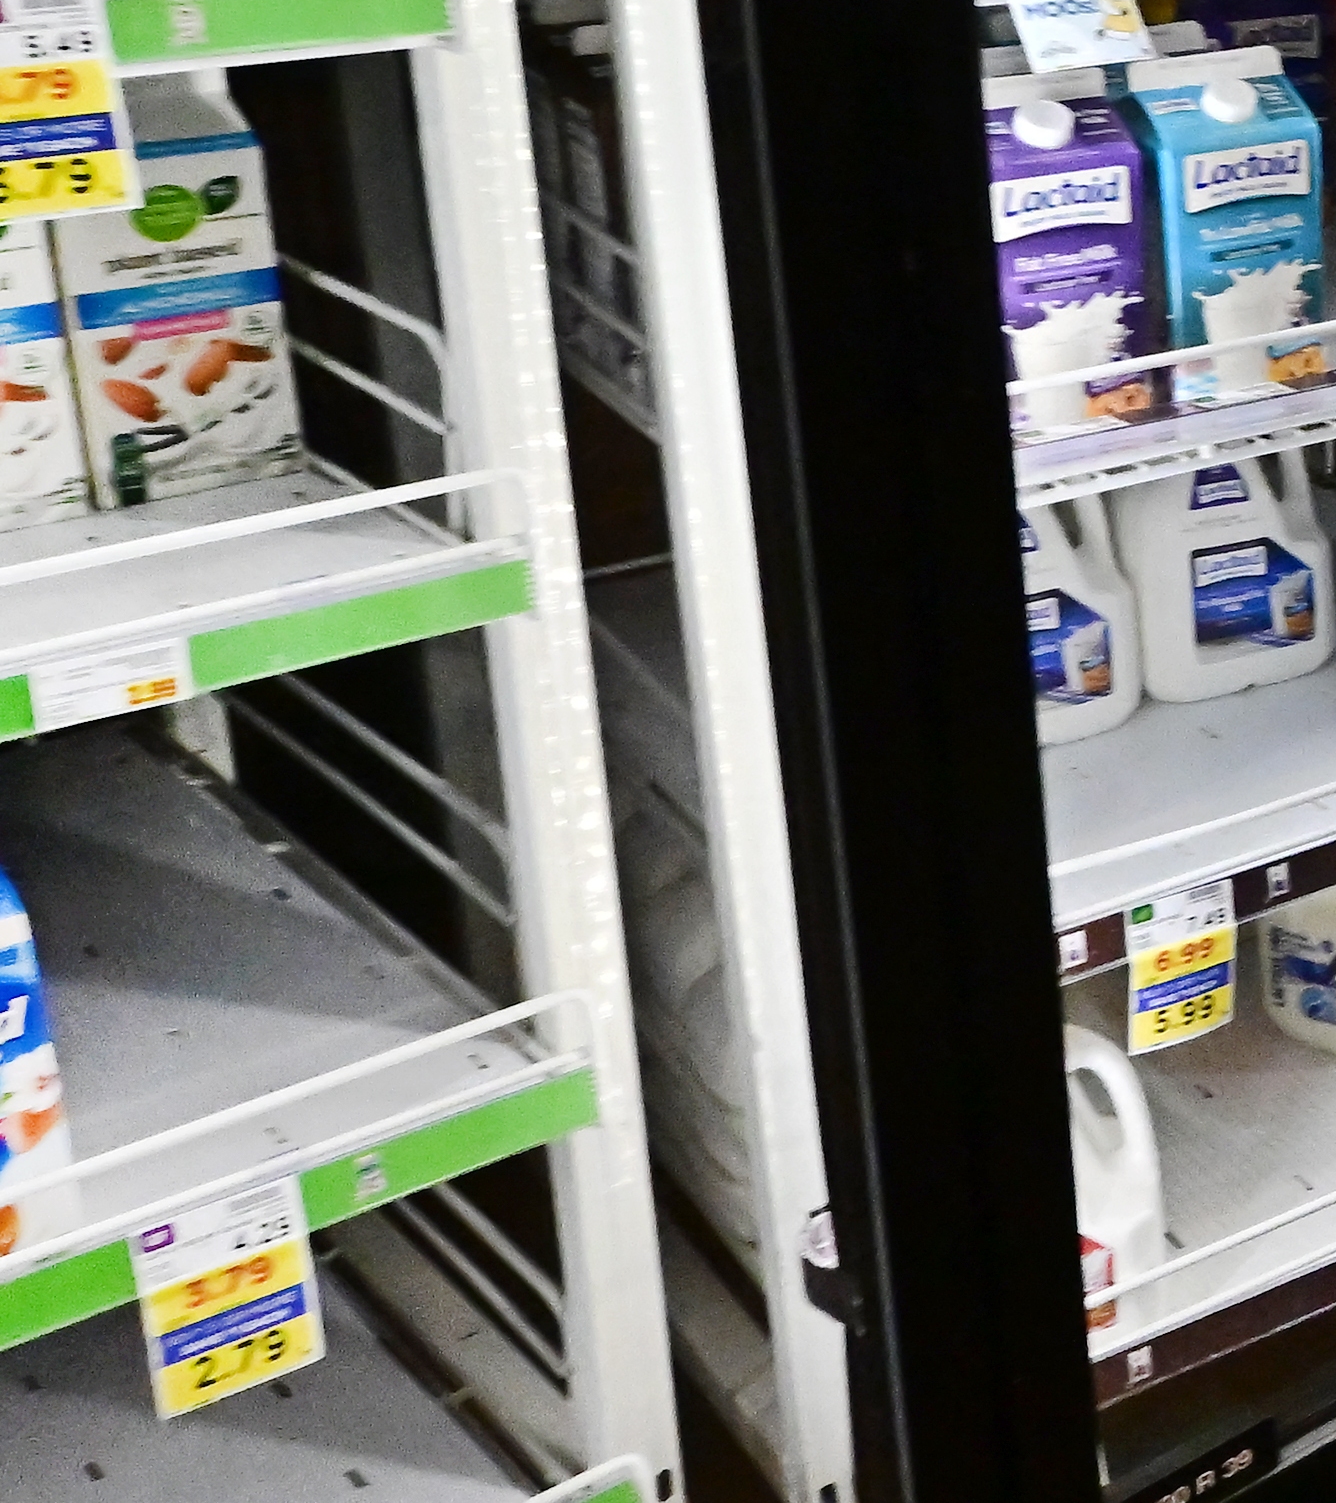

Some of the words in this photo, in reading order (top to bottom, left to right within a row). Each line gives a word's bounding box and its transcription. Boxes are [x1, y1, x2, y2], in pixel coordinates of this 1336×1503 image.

[1194, 145, 1302, 190] Lactaid
[1003, 171, 1121, 218] Lactaid
[1154, 937, 1214, 972] 6.99
[1153, 994, 1216, 1034] 5.99
[185, 1253, 271, 1309] 3.79
[193, 1329, 286, 1389] 2.79
[1221, 1448, 1254, 1478] 39
